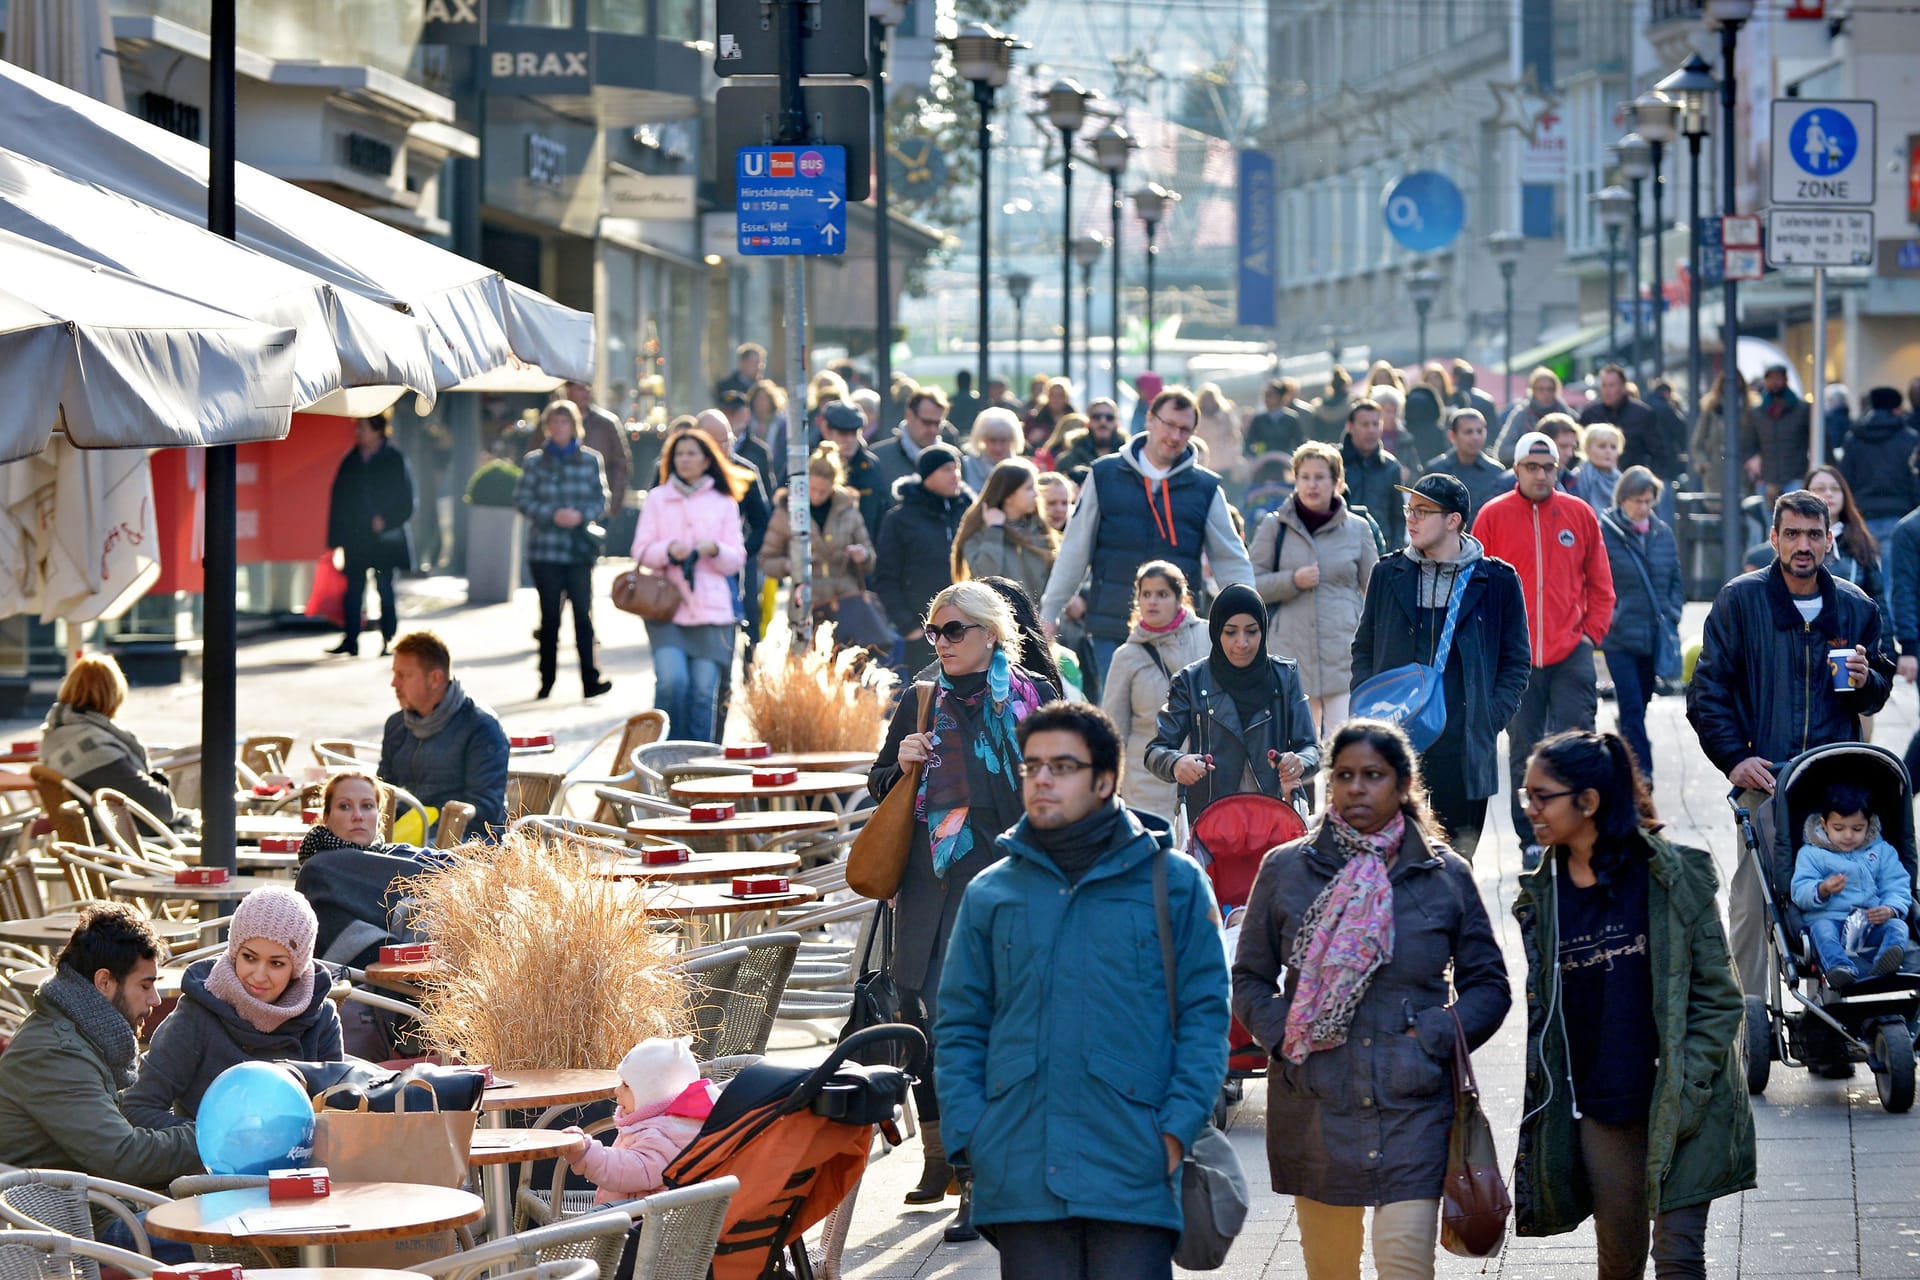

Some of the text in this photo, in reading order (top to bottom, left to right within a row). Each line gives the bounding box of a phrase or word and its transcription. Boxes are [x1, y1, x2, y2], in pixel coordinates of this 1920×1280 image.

[425, 0, 478, 23] AX
[491, 52, 588, 77] BRAX
[744, 154, 823, 176] U Tram BUS
[741, 187, 814, 199] Hirschlandplatz
[1796, 180, 1849, 199] ZONE
[761, 201, 777, 211] 150
[779, 203, 789, 211] m
[741, 221, 788, 233] Essen Hbf
[771, 236, 791, 246] 300
[791, 238, 802, 246] m
[1571, 934, 1592, 943] ARE
